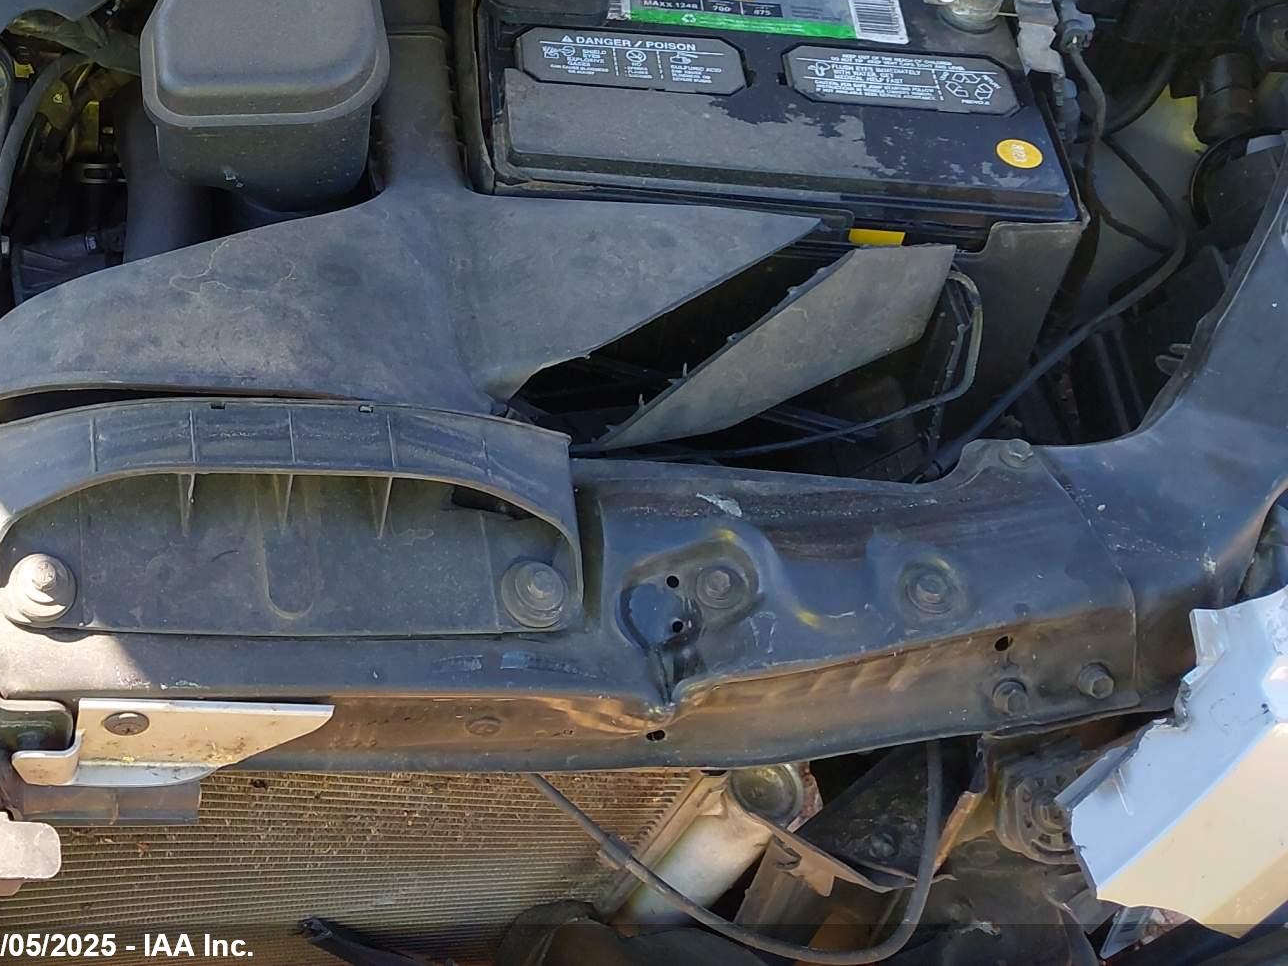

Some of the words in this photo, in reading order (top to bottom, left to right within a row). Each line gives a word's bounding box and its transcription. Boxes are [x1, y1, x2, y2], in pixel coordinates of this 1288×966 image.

[643, 0, 672, 8] MAXX
[575, 36, 632, 47] DANGER
[645, 41, 697, 51] POISON
